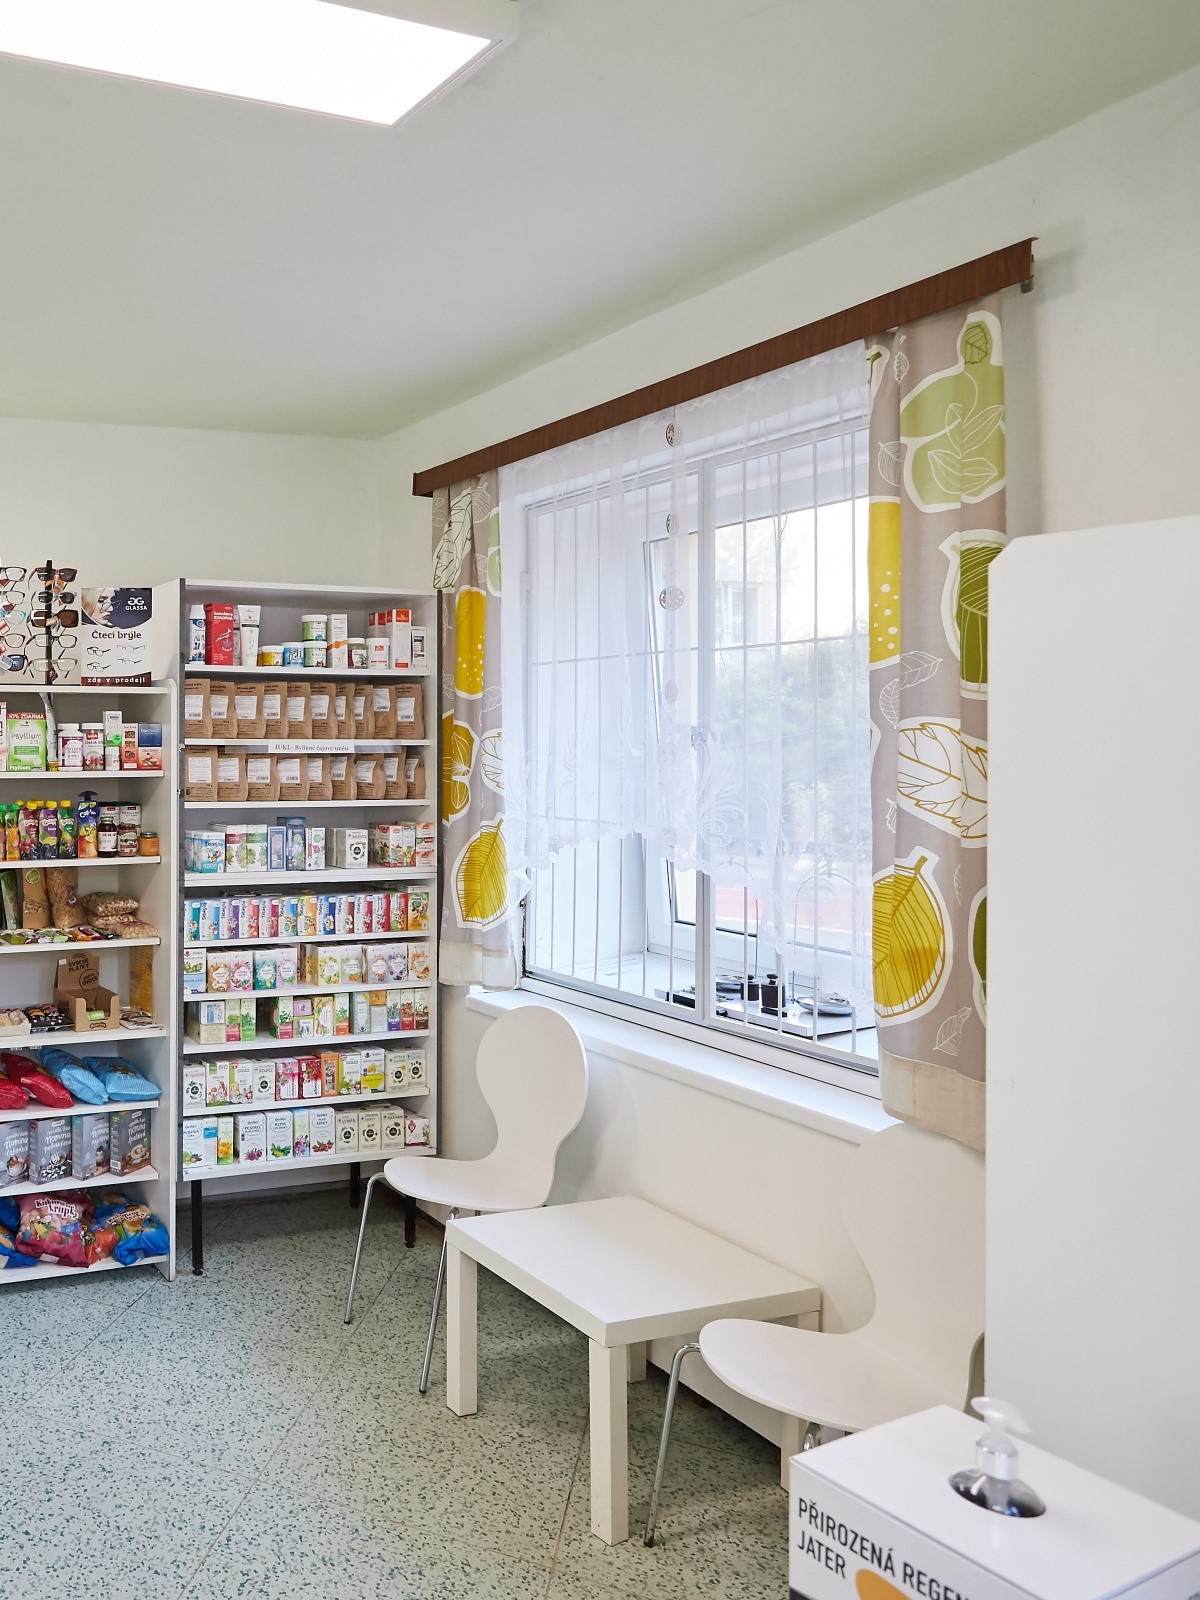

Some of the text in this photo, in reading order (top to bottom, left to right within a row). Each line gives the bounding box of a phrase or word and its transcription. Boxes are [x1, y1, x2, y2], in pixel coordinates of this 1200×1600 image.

[91, 630, 142, 640] Čtecí brýle
[11, 731, 41, 741] Psyllium
[798, 1496, 896, 1578] PŘIROZENÁ
[796, 1530, 846, 1579] JATER
